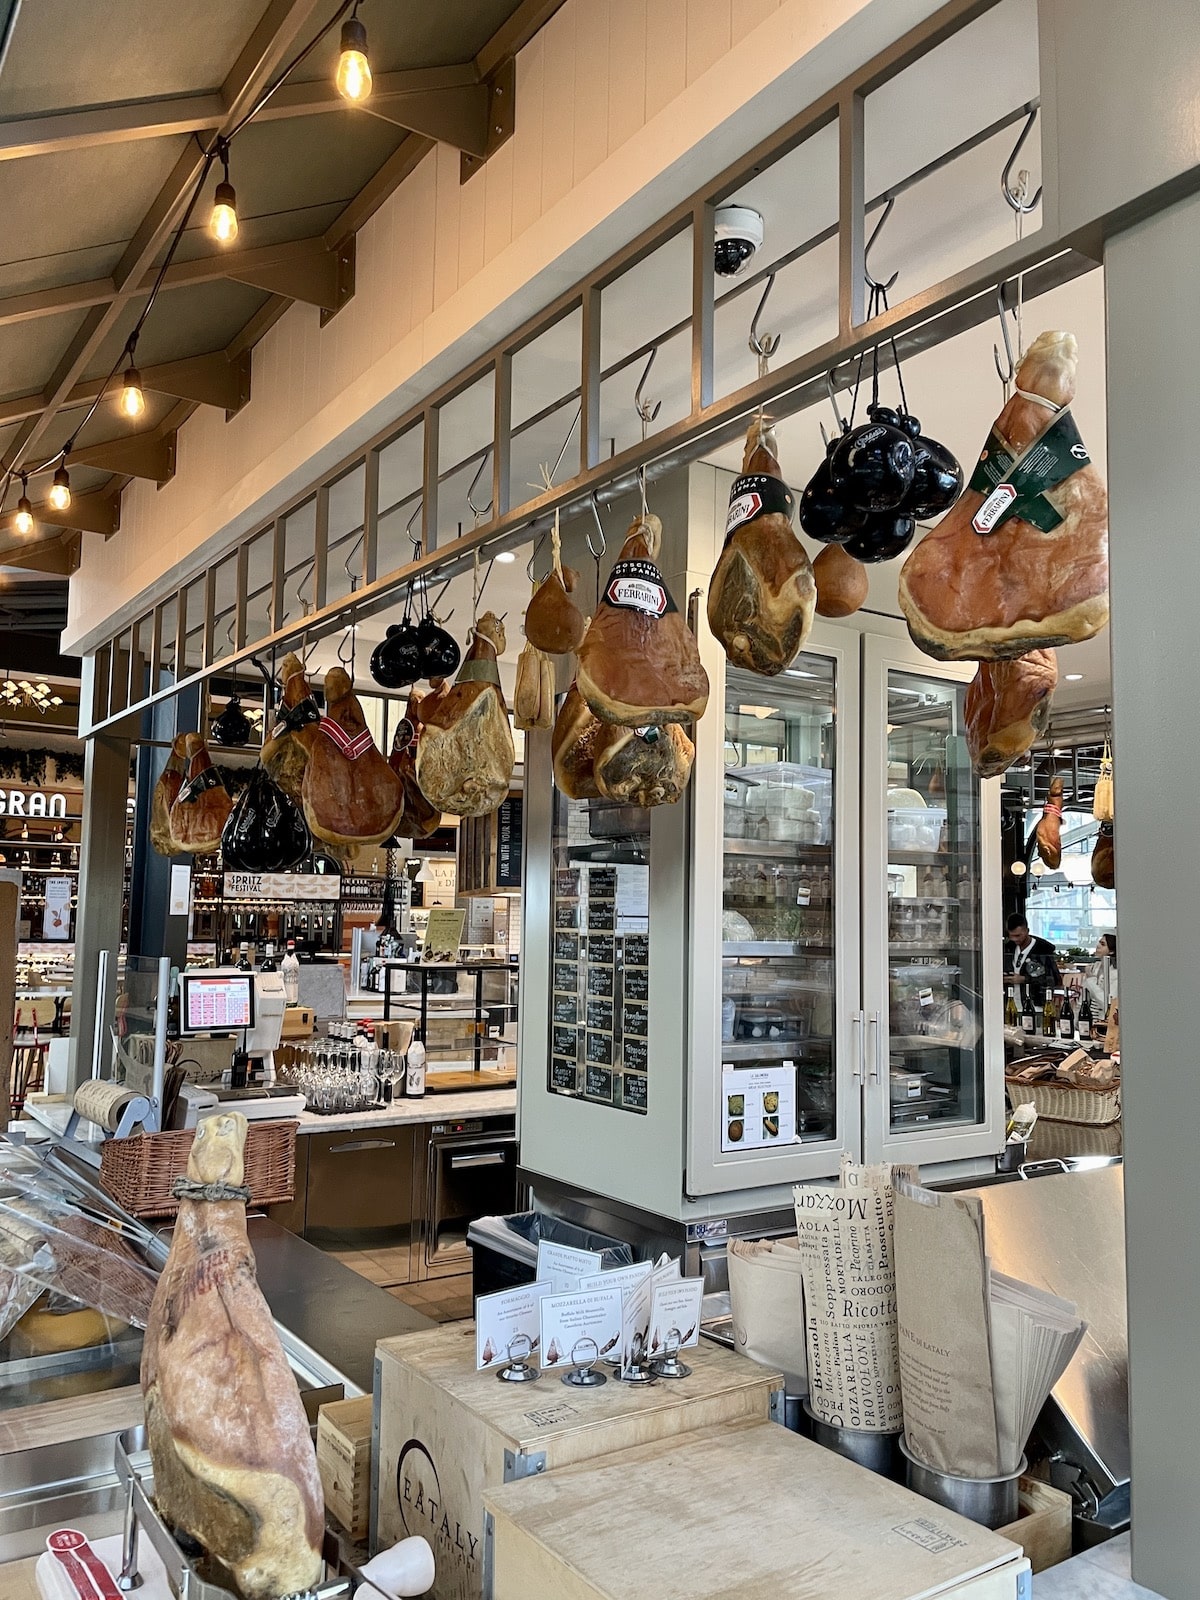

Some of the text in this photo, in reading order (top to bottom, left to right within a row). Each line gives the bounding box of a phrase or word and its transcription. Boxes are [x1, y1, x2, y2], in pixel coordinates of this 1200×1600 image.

[982, 492, 1010, 527] FERRARINI
[631, 567, 661, 579] PARMA
[617, 588, 659, 606] FERRARINI
[500, 844, 510, 862] WITH
[501, 825, 511, 843] YOUR
[231, 875, 262, 885] SPRITZ
[798, 1222, 830, 1232] AOLA
[849, 1226, 861, 1271] Pecorino
[864, 1225, 874, 1271] CIABATTA
[875, 1197, 888, 1270] Prosciutto
[822, 1237, 836, 1318] Soppressata
[833, 1217, 847, 1294] MORTADELLA
[551, 1300, 586, 1308] MOZZARELLA
[808, 1318, 823, 1389] Bresaola
[824, 1332, 834, 1394] Melanzana
[833, 1331, 841, 1366] Piadina
[856, 1334, 876, 1427] PROVOLONE
[875, 1380, 887, 1427] BASILICO
[404, 1476, 479, 1560] EATALY
